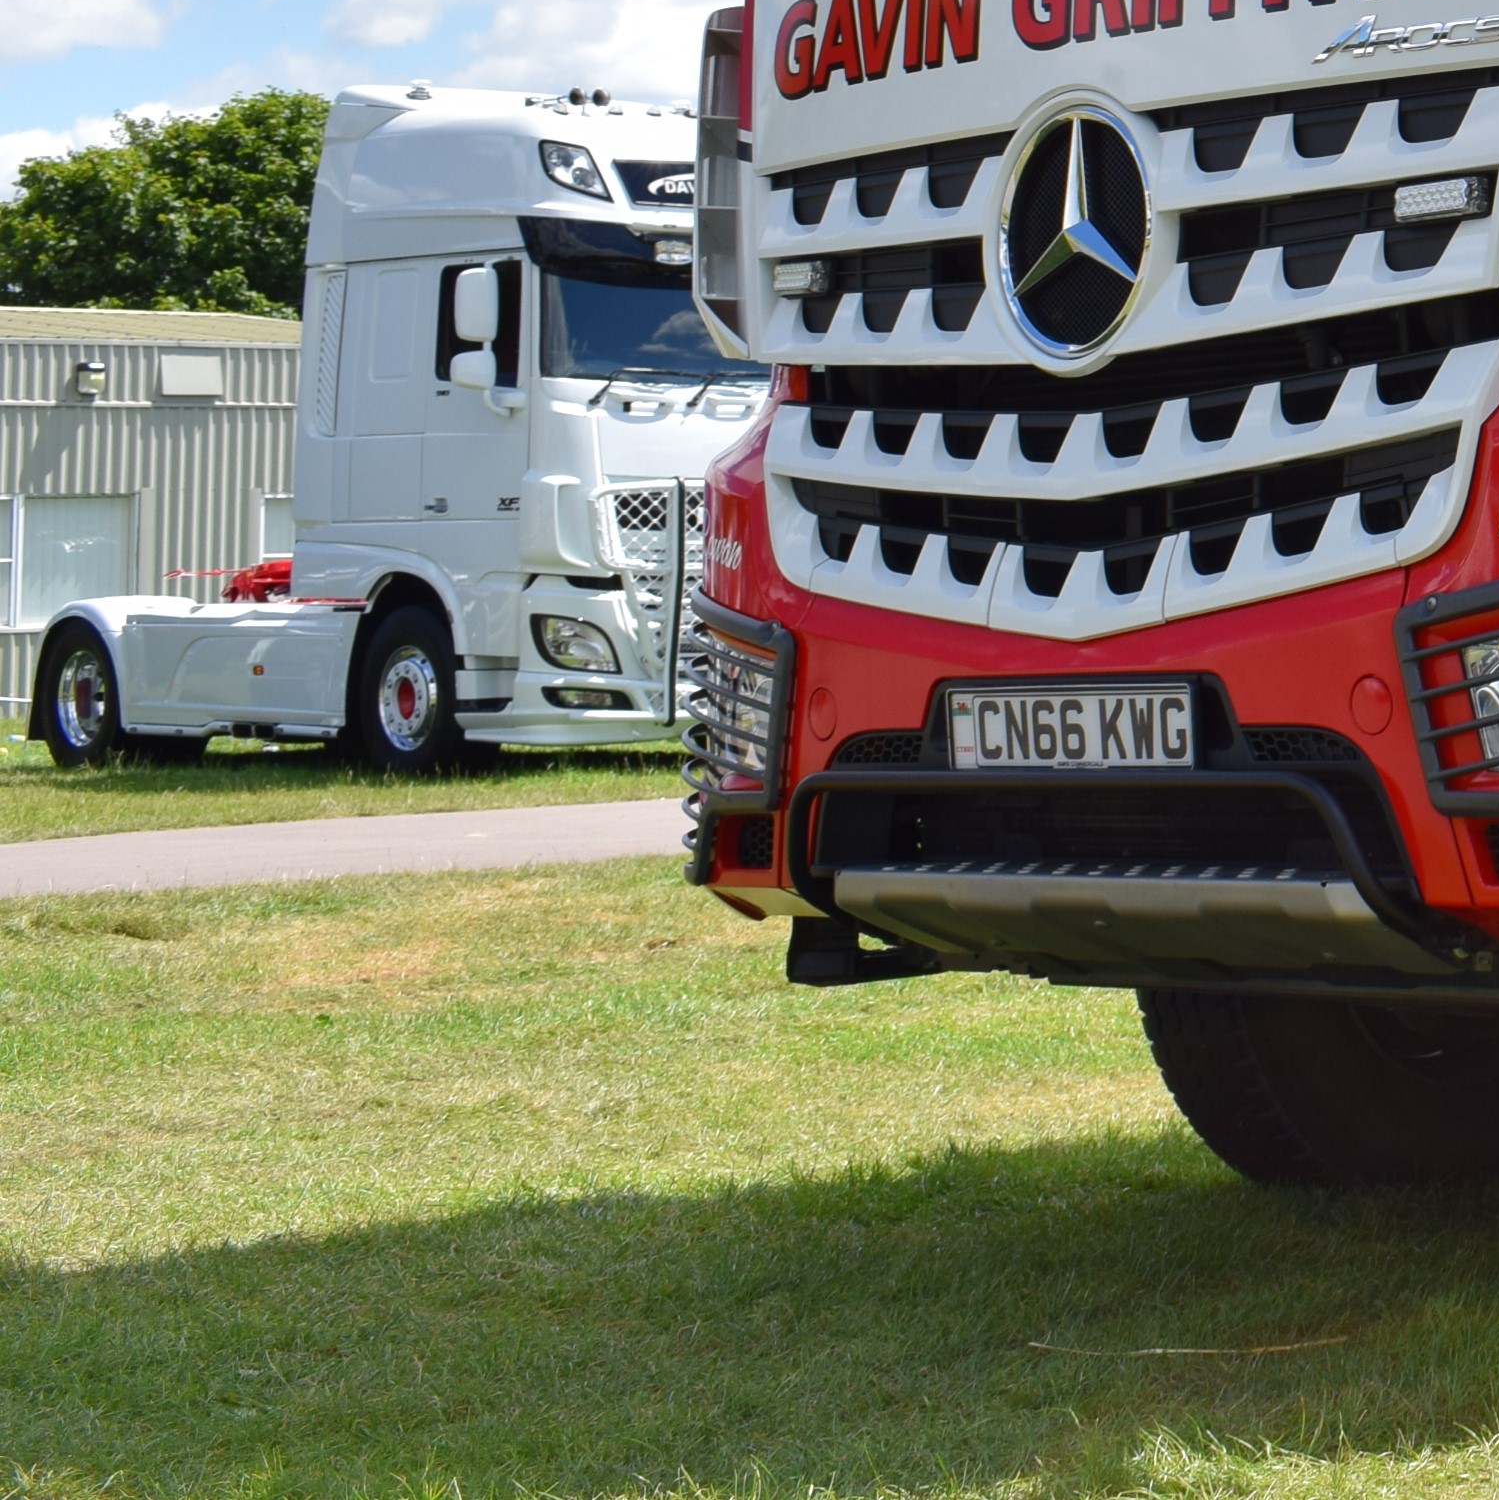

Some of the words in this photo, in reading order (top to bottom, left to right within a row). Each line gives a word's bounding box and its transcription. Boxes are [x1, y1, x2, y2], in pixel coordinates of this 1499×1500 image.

[498, 497, 520, 507] XF
[978, 699, 1086, 760] CN66
[1098, 697, 1188, 760] KWG
